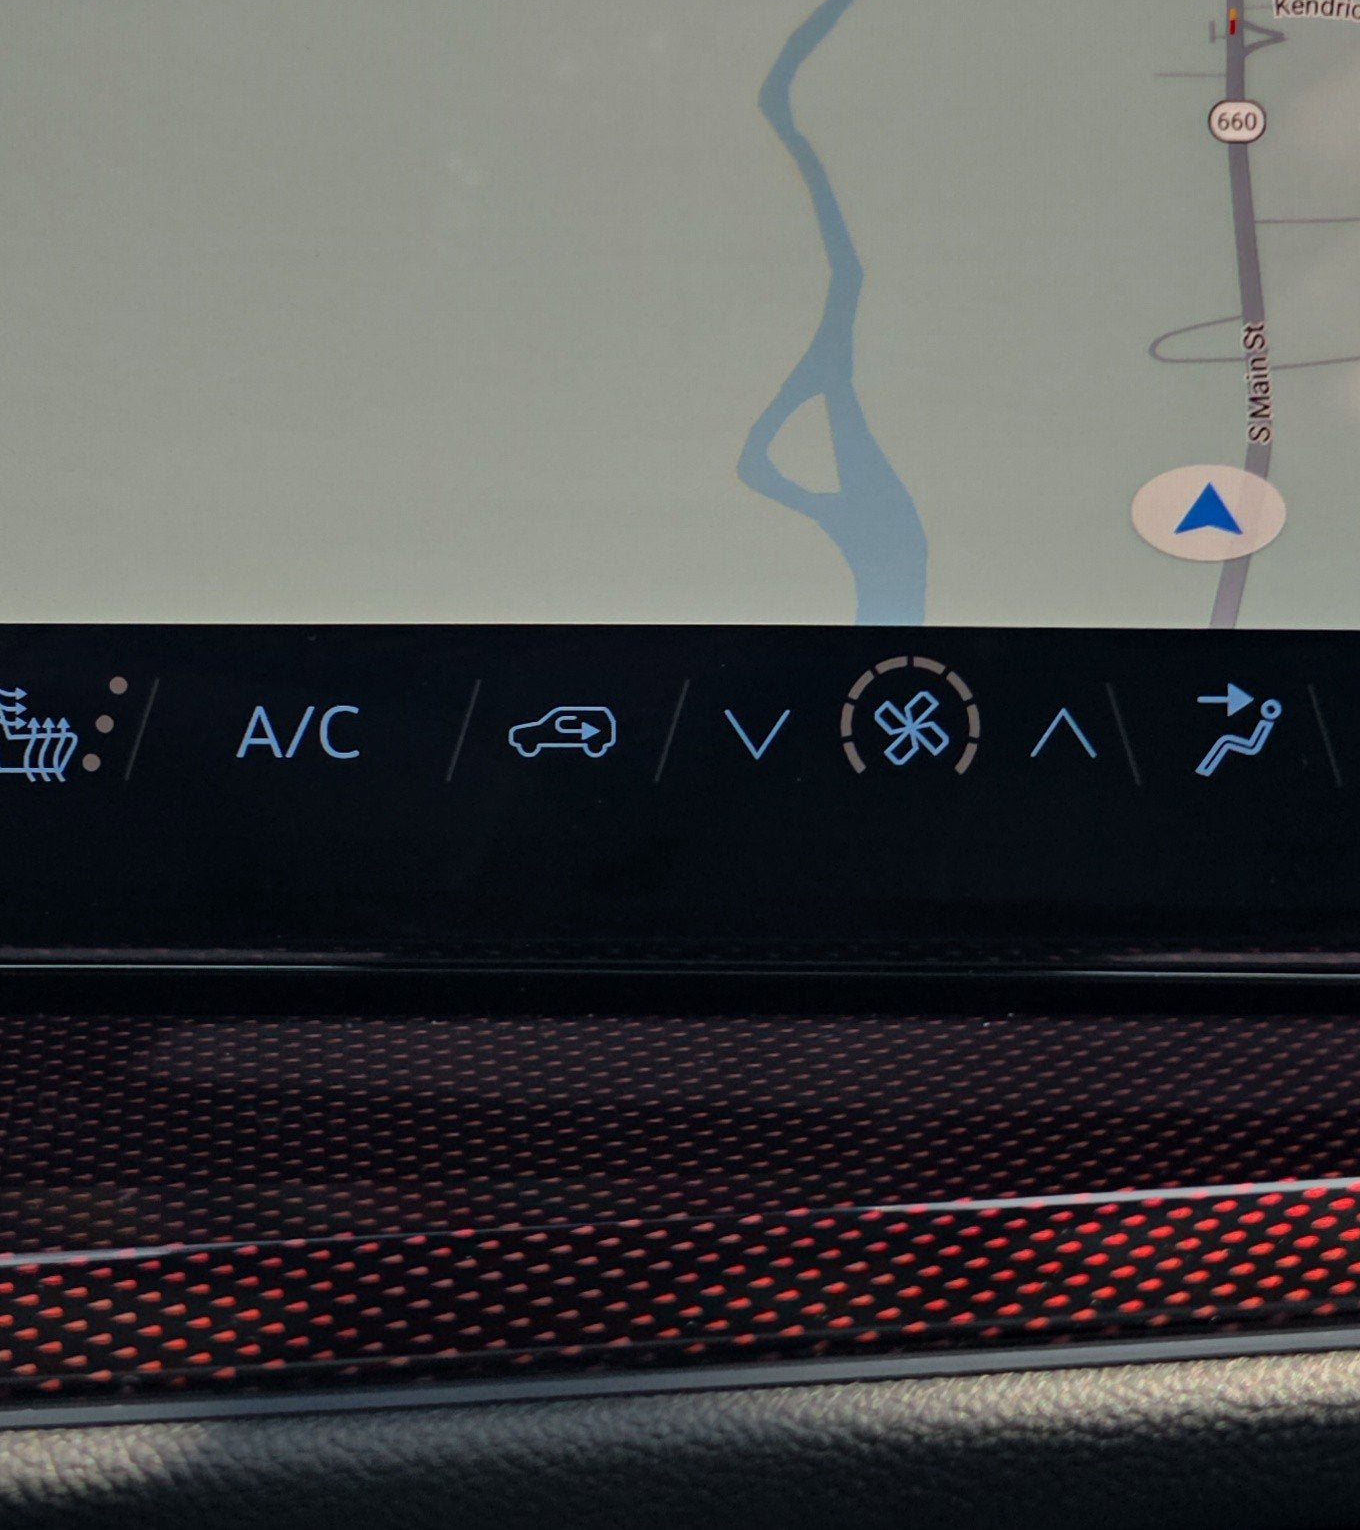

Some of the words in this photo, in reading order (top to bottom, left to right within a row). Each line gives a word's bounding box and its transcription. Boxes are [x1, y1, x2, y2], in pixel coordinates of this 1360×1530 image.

[1217, 110, 1259, 132] 660
[1243, 324, 1266, 350] St
[1245, 356, 1271, 419] Main
[1248, 425, 1271, 443] S
[235, 704, 361, 759] A/C
